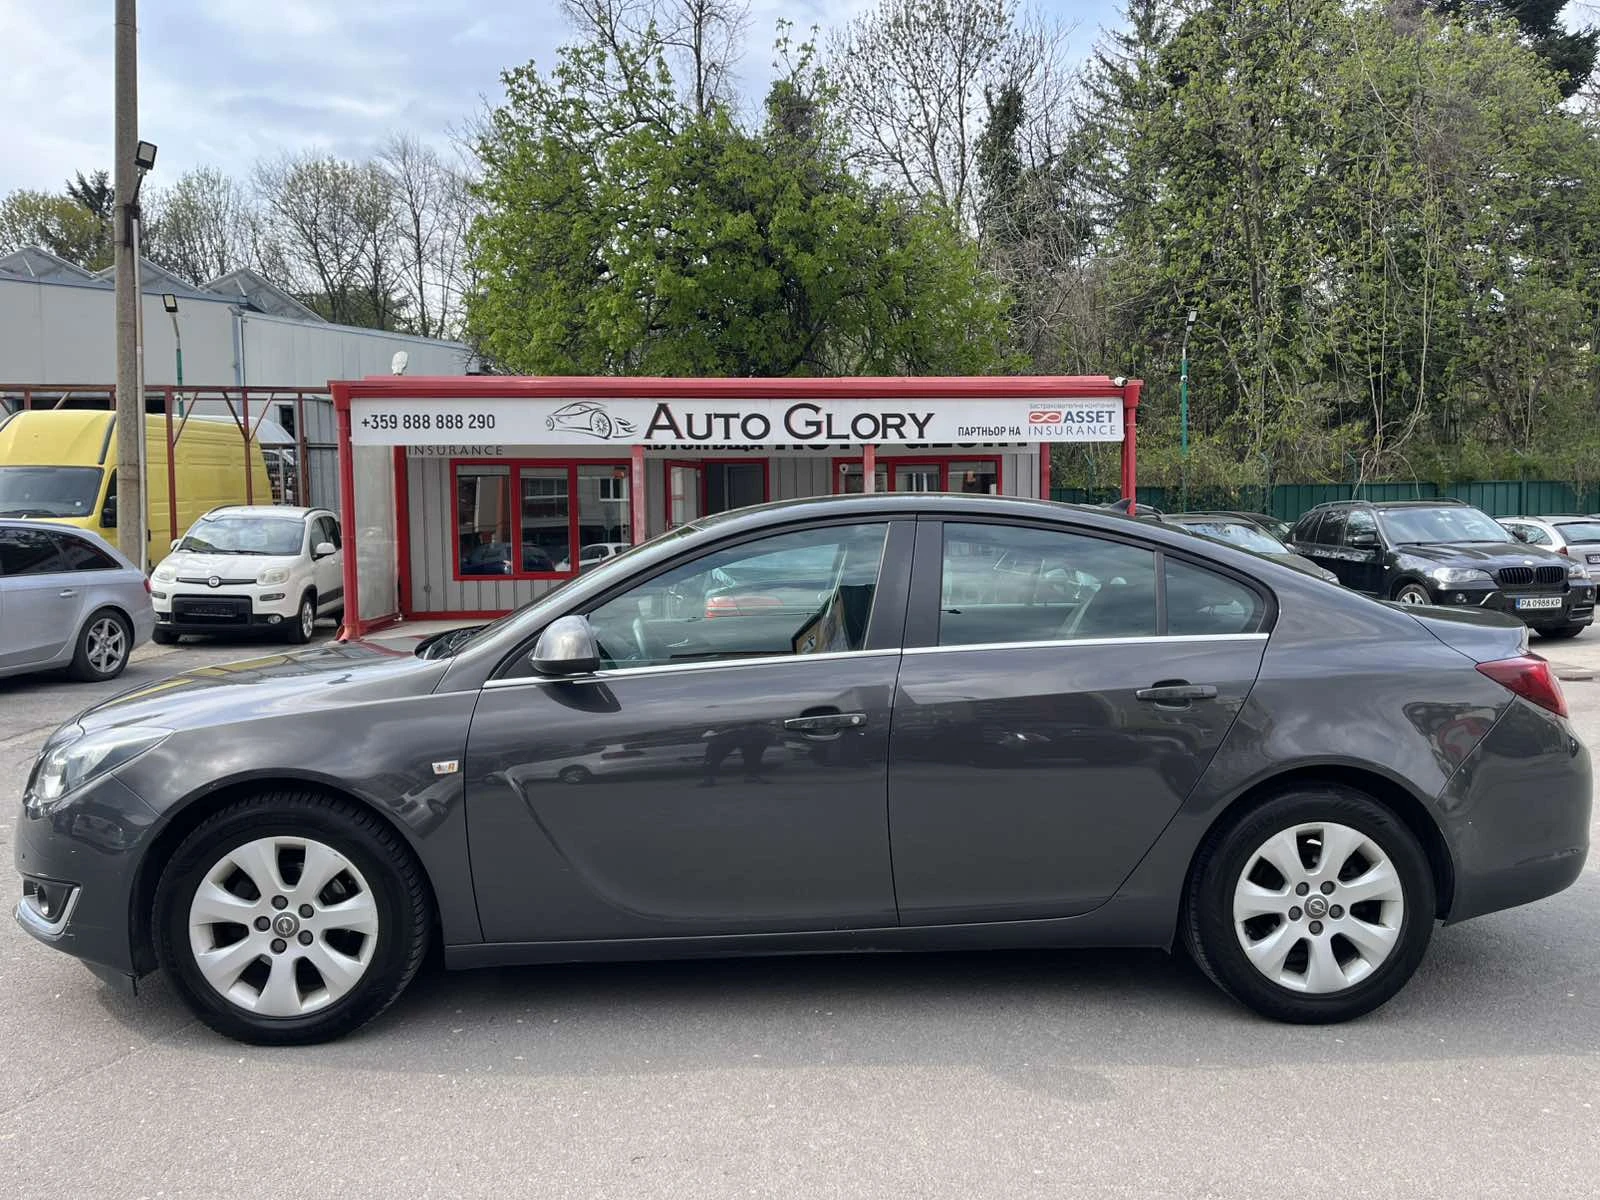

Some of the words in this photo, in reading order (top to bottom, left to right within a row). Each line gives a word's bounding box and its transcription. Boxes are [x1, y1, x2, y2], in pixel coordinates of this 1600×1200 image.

[361, 414, 398, 429] +359
[402, 414, 431, 429] 888
[435, 414, 464, 429] 888
[468, 414, 496, 429] 290
[1063, 410, 1116, 424] ASSET
[958, 426, 1006, 437] ПАРТНЬОР
[1009, 426, 1021, 436] НА
[1028, 425, 1117, 436] INSURANCE
[408, 445, 504, 456] INSURANCE
